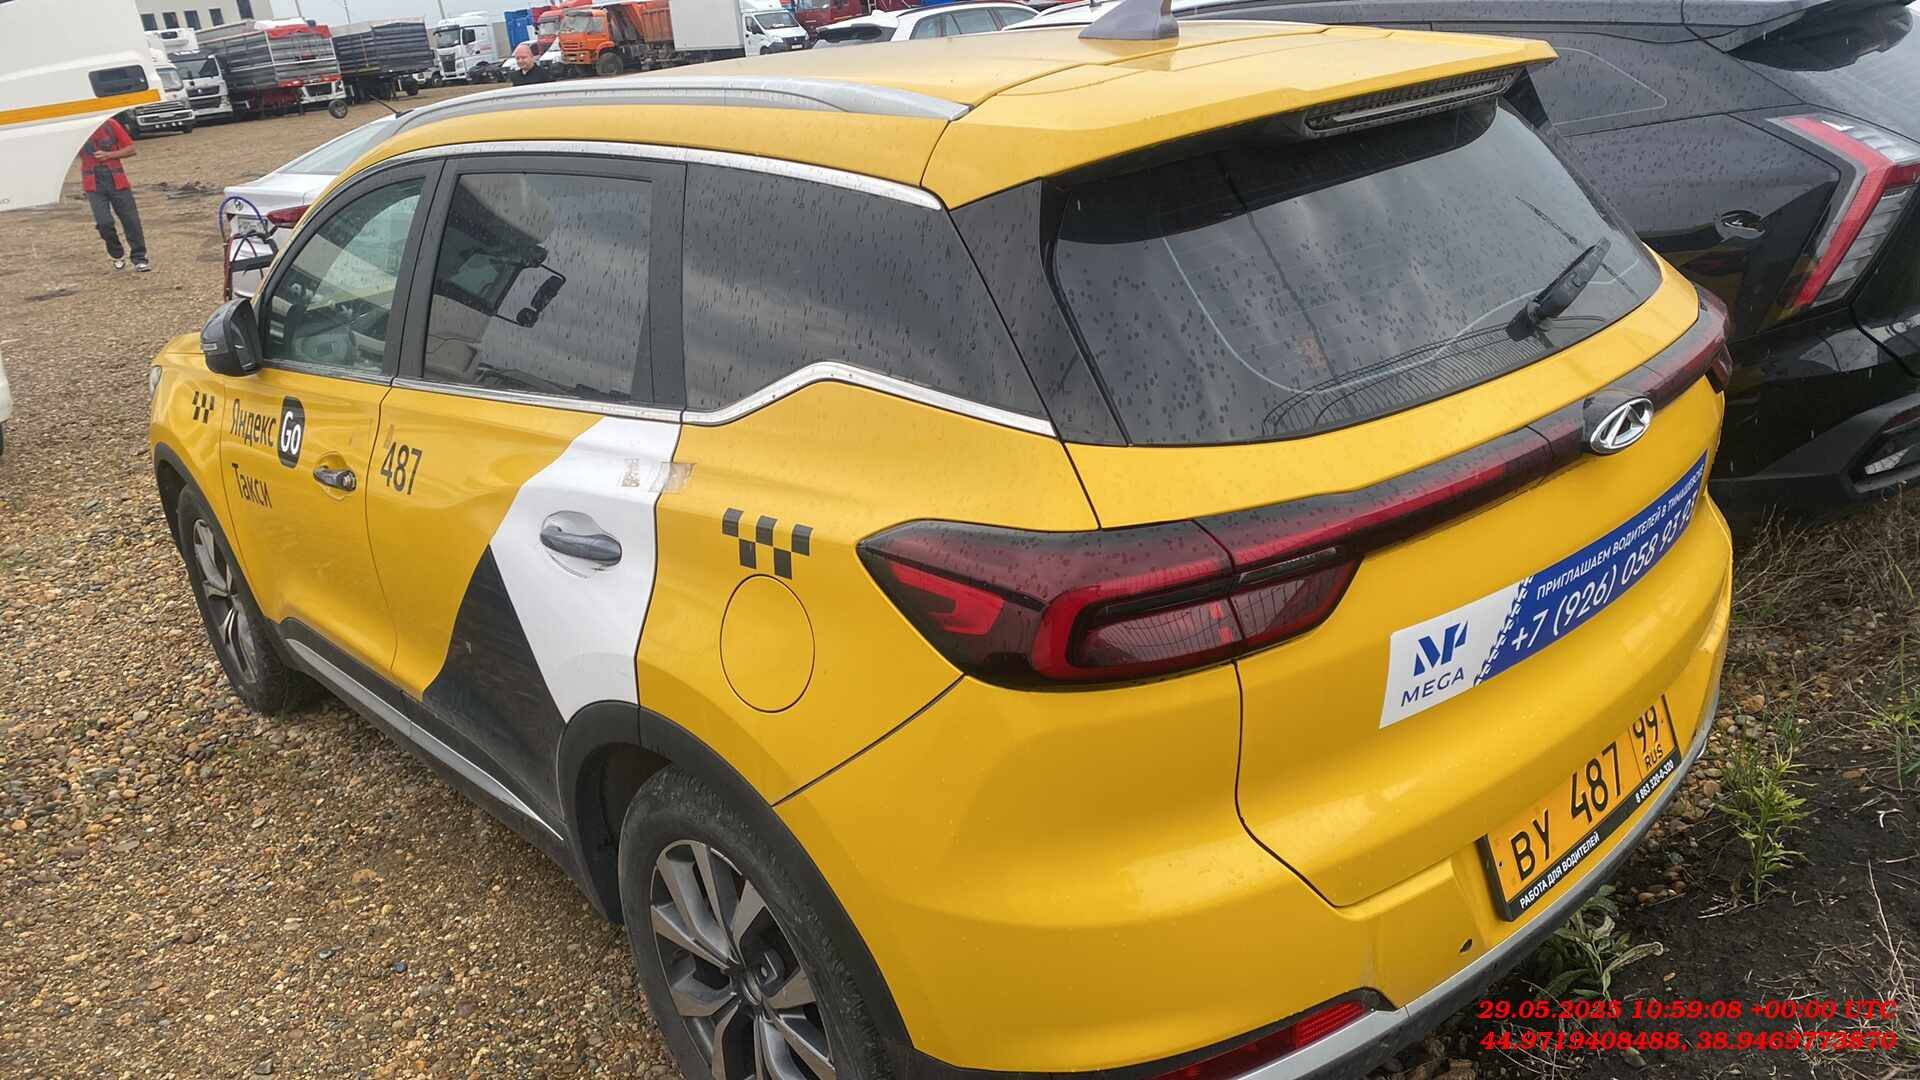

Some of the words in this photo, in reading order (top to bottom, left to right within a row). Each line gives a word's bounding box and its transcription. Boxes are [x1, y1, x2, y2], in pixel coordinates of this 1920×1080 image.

[229, 398, 277, 447] Яндекс
[280, 410, 301, 455] Go
[231, 462, 272, 509] Такси
[380, 441, 422, 495] 487
[1511, 608, 1549, 651] +7
[1553, 564, 1617, 636] (926)
[1621, 533, 1659, 585] 058
[1659, 510, 1681, 552] 93
[1536, 547, 1611, 600] ПРИГЛАШАЕМ
[1612, 506, 1661, 555] ВОДИТЕЛЕЙ
[1661, 505, 1667, 518] В
[1401, 667, 1465, 707] MEGA
[1571, 742, 1621, 824] 487
[1633, 705, 1659, 752] 99
[1645, 743, 1663, 769] RUS
[1520, 879, 1548, 909] РАБОТА
[1546, 865, 1563, 887] ДЛЯ
[1561, 831, 1600, 872] ВОДИТЕЛЕЙ
